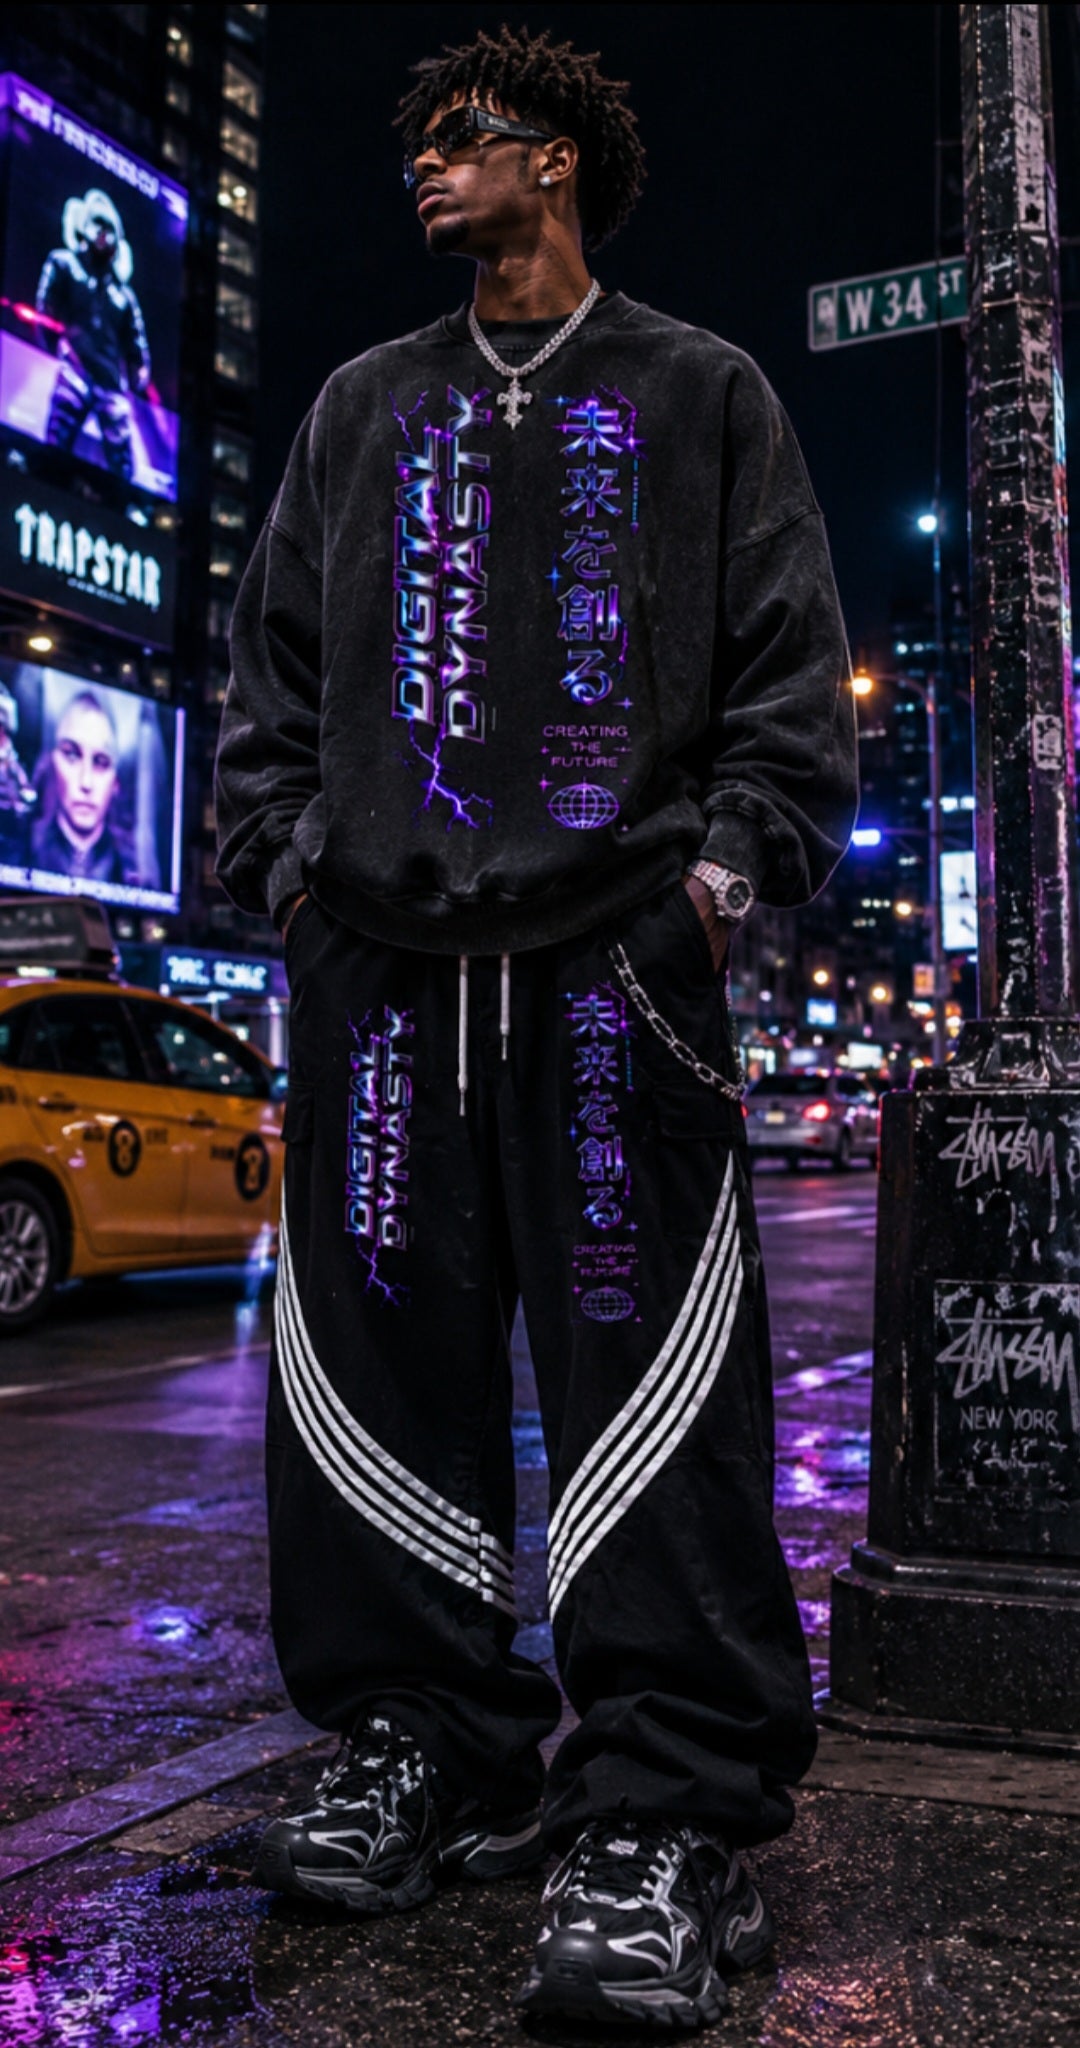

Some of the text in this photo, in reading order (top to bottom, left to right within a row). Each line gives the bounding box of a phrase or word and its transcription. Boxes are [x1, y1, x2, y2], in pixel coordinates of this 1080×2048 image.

[845, 268, 963, 334] W 34 ST
[14, 503, 161, 612] TRAPSTAR
[391, 426, 440, 726] DIGITAL
[442, 384, 492, 743] DYNASTY
[557, 399, 623, 705] 未来を創る
[542, 724, 629, 738] CREATING
[550, 756, 619, 768] FUTURE
[570, 741, 601, 755] THE
[345, 1034, 378, 1237] DIGITAL
[377, 1004, 415, 1249] DYNASTY
[570, 993, 624, 1230] 未来を創る
[960, 1405, 1004, 1433] NEW
